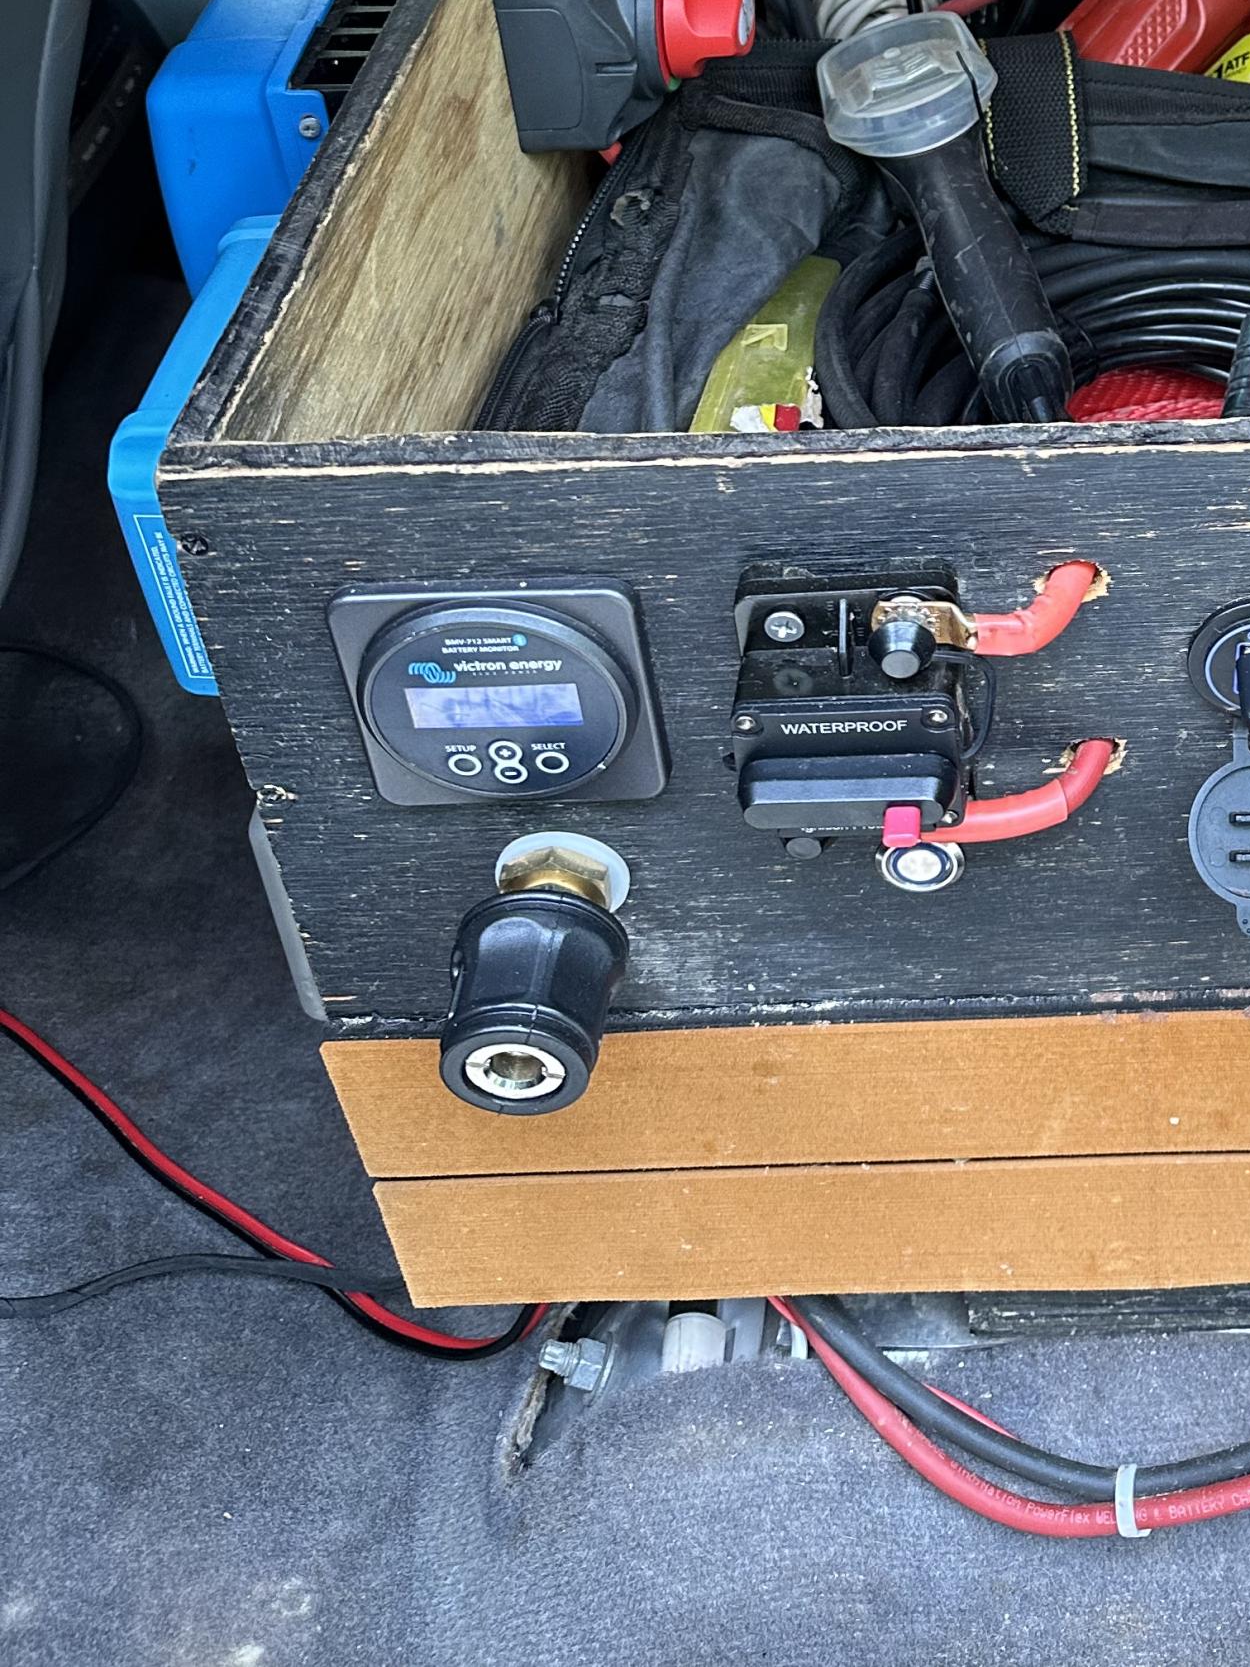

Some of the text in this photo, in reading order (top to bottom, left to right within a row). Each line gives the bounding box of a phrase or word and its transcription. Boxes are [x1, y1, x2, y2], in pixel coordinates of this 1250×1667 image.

[1224, 50, 1250, 75] ATF
[156, 538, 168, 553] MAY
[161, 552, 176, 577] CIRCUITS
[161, 580, 175, 599] FAULT
[169, 576, 187, 610] CONNECTED
[167, 597, 183, 623] GROUND
[181, 609, 192, 623] AND
[178, 626, 191, 645] WHEN
[444, 637, 512, 646] BMV-712 SMART
[441, 645, 520, 654] BATTERY MONITOR
[194, 651, 209, 674] BATTERY
[453, 659, 563, 672] victron energy
[780, 719, 908, 735] WATERPROOF
[445, 745, 477, 753] SETUP
[530, 742, 566, 751] SELECT
[1025, 1502, 1090, 1525] PowerFlex
[1096, 1506, 1148, 1525] WELNG
[1169, 1498, 1225, 1520] BATTERY
